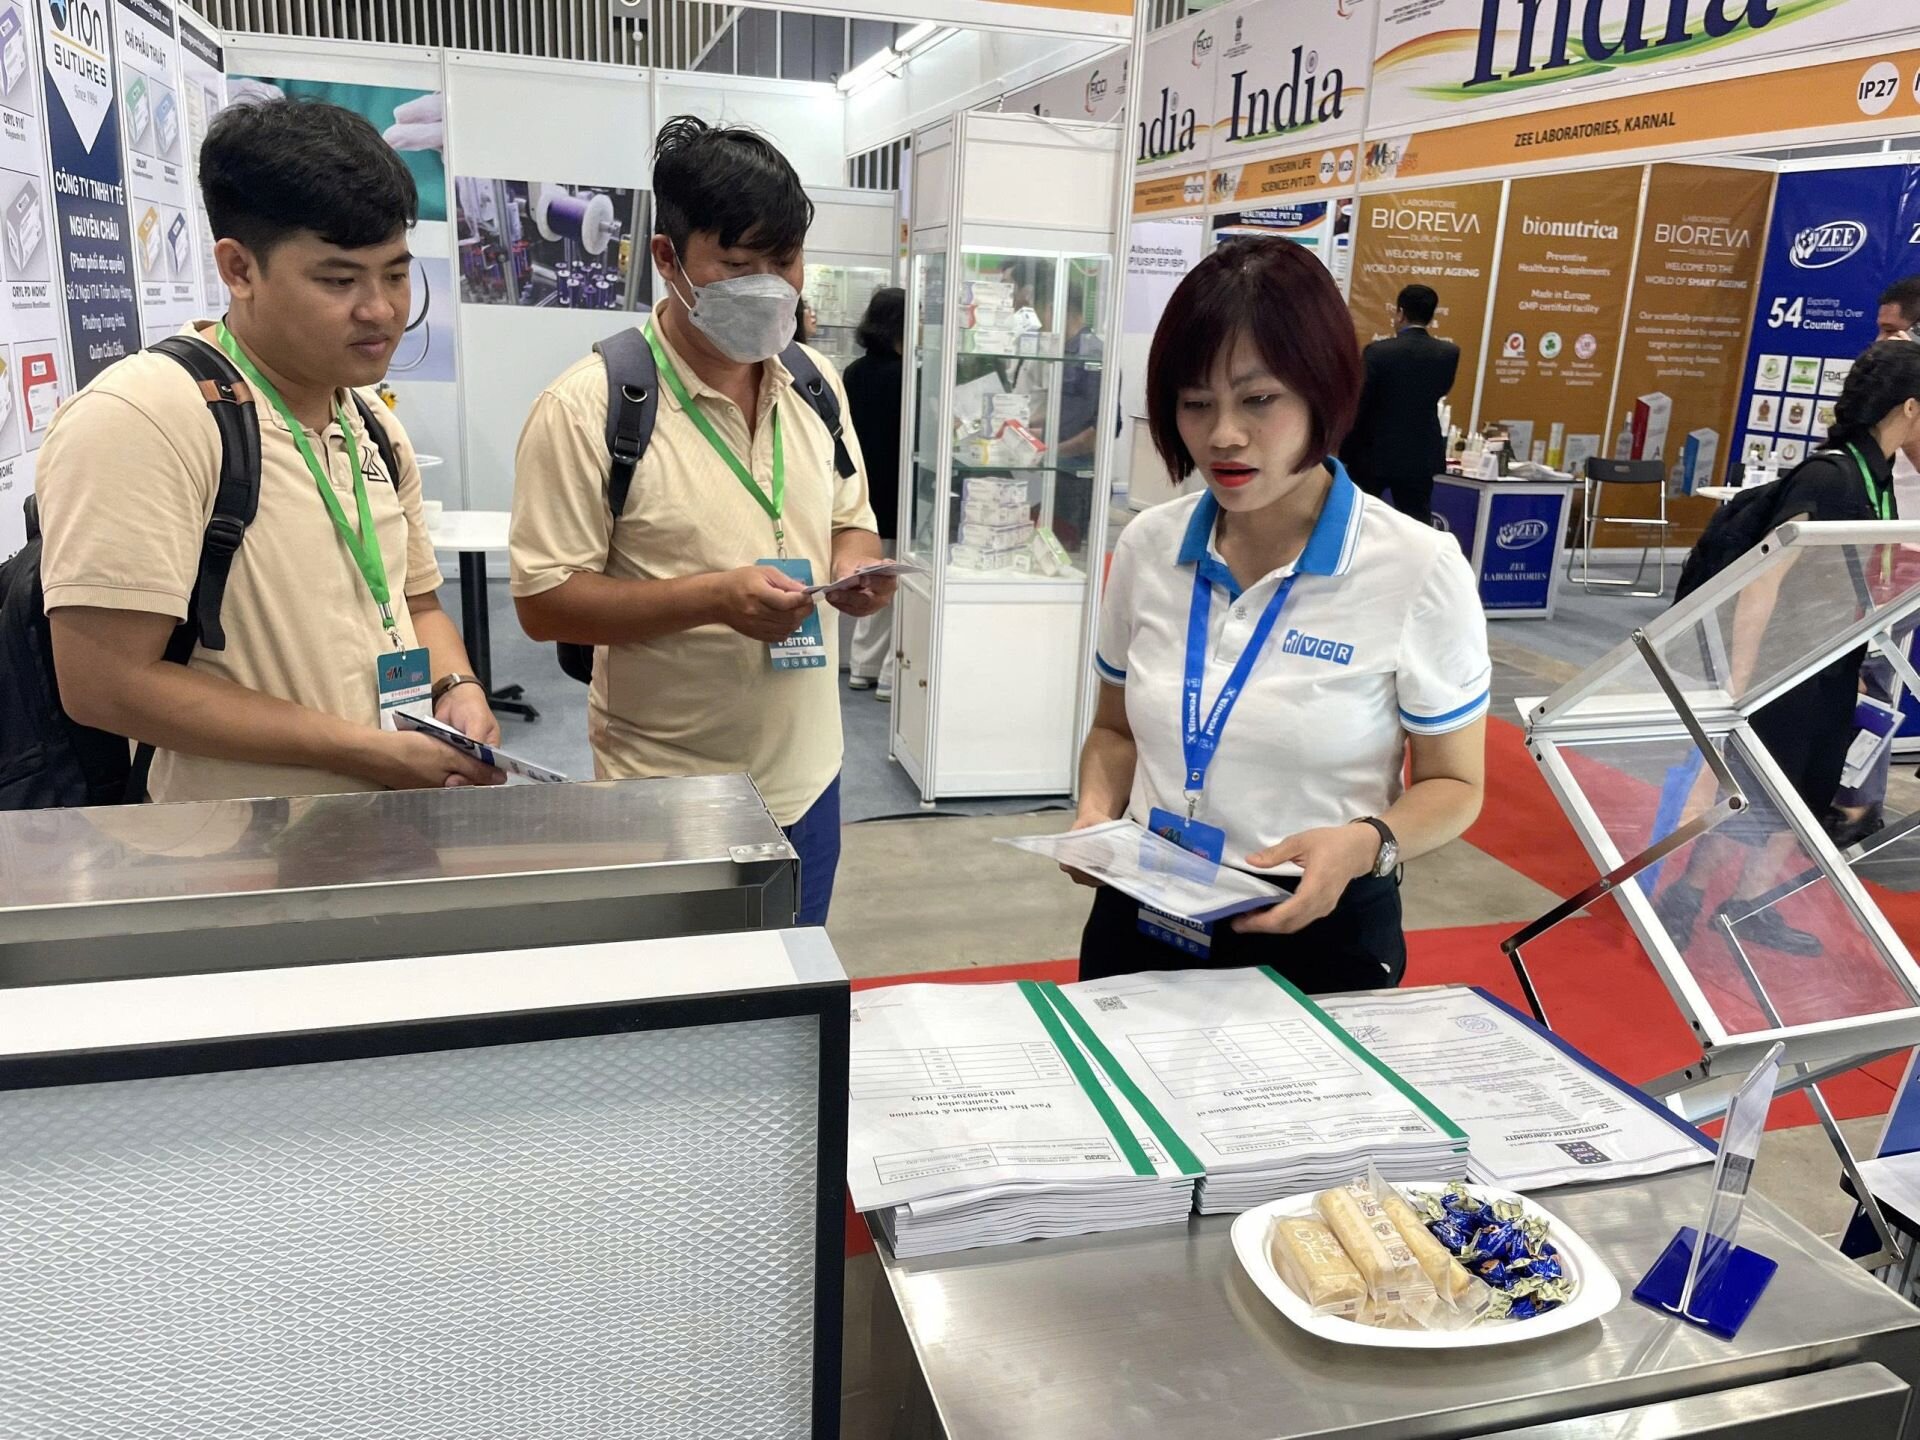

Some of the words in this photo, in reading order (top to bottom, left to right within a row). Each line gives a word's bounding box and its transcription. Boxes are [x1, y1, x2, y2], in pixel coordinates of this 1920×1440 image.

[54, 43, 107, 88] SUTURES
[1226, 45, 1343, 142] India
[1859, 78, 1898, 100] IP27
[1515, 132, 1533, 147] ZEE
[1535, 118, 1622, 145] LABORATORIES,
[1624, 112, 1676, 132] KARNAL
[55, 167, 79, 195] CÔNG
[79, 178, 89, 198] TY
[89, 180, 109, 203] TNHH
[108, 186, 114, 205] Y
[114, 179, 125, 206] TẾ
[1371, 208, 1480, 234] BIOREVA
[1522, 215, 1619, 241] bionutrica
[1655, 223, 1750, 248] BIOREVA
[1818, 227, 1856, 247] ZEE
[1131, 244, 1182, 256] Albendazole
[1385, 248, 1429, 261] WELCOME
[1431, 250, 1444, 261] TO
[1446, 251, 1463, 262] THE
[1546, 251, 1588, 263] Preventive
[1363, 263, 1397, 275] WORLD
[1399, 264, 1411, 275] OF
[1411, 265, 1443, 276] SMART
[1444, 267, 1480, 278] AGEING
[1518, 263, 1560, 274] Healthcare
[1665, 261, 1704, 272] WELCOME
[1646, 275, 1675, 286] WORLD
[1688, 277, 1716, 288] SMART
[1717, 278, 1747, 289] AGEING
[1531, 289, 1553, 299] Made
[1563, 290, 1591, 302] Europe
[1768, 297, 1804, 329] 54
[1845, 309, 1864, 318] Over
[1803, 319, 1844, 331] Countries
[1517, 524, 1542, 536] ZEE
[1509, 562, 1525, 571] ZEE
[1484, 572, 1546, 581] LABORATORIES
[1303, 638, 1352, 664] VCR
[1504, 1131, 1552, 1142] CONFORMITY
[1564, 1122, 1609, 1137] CERTIFICATE
